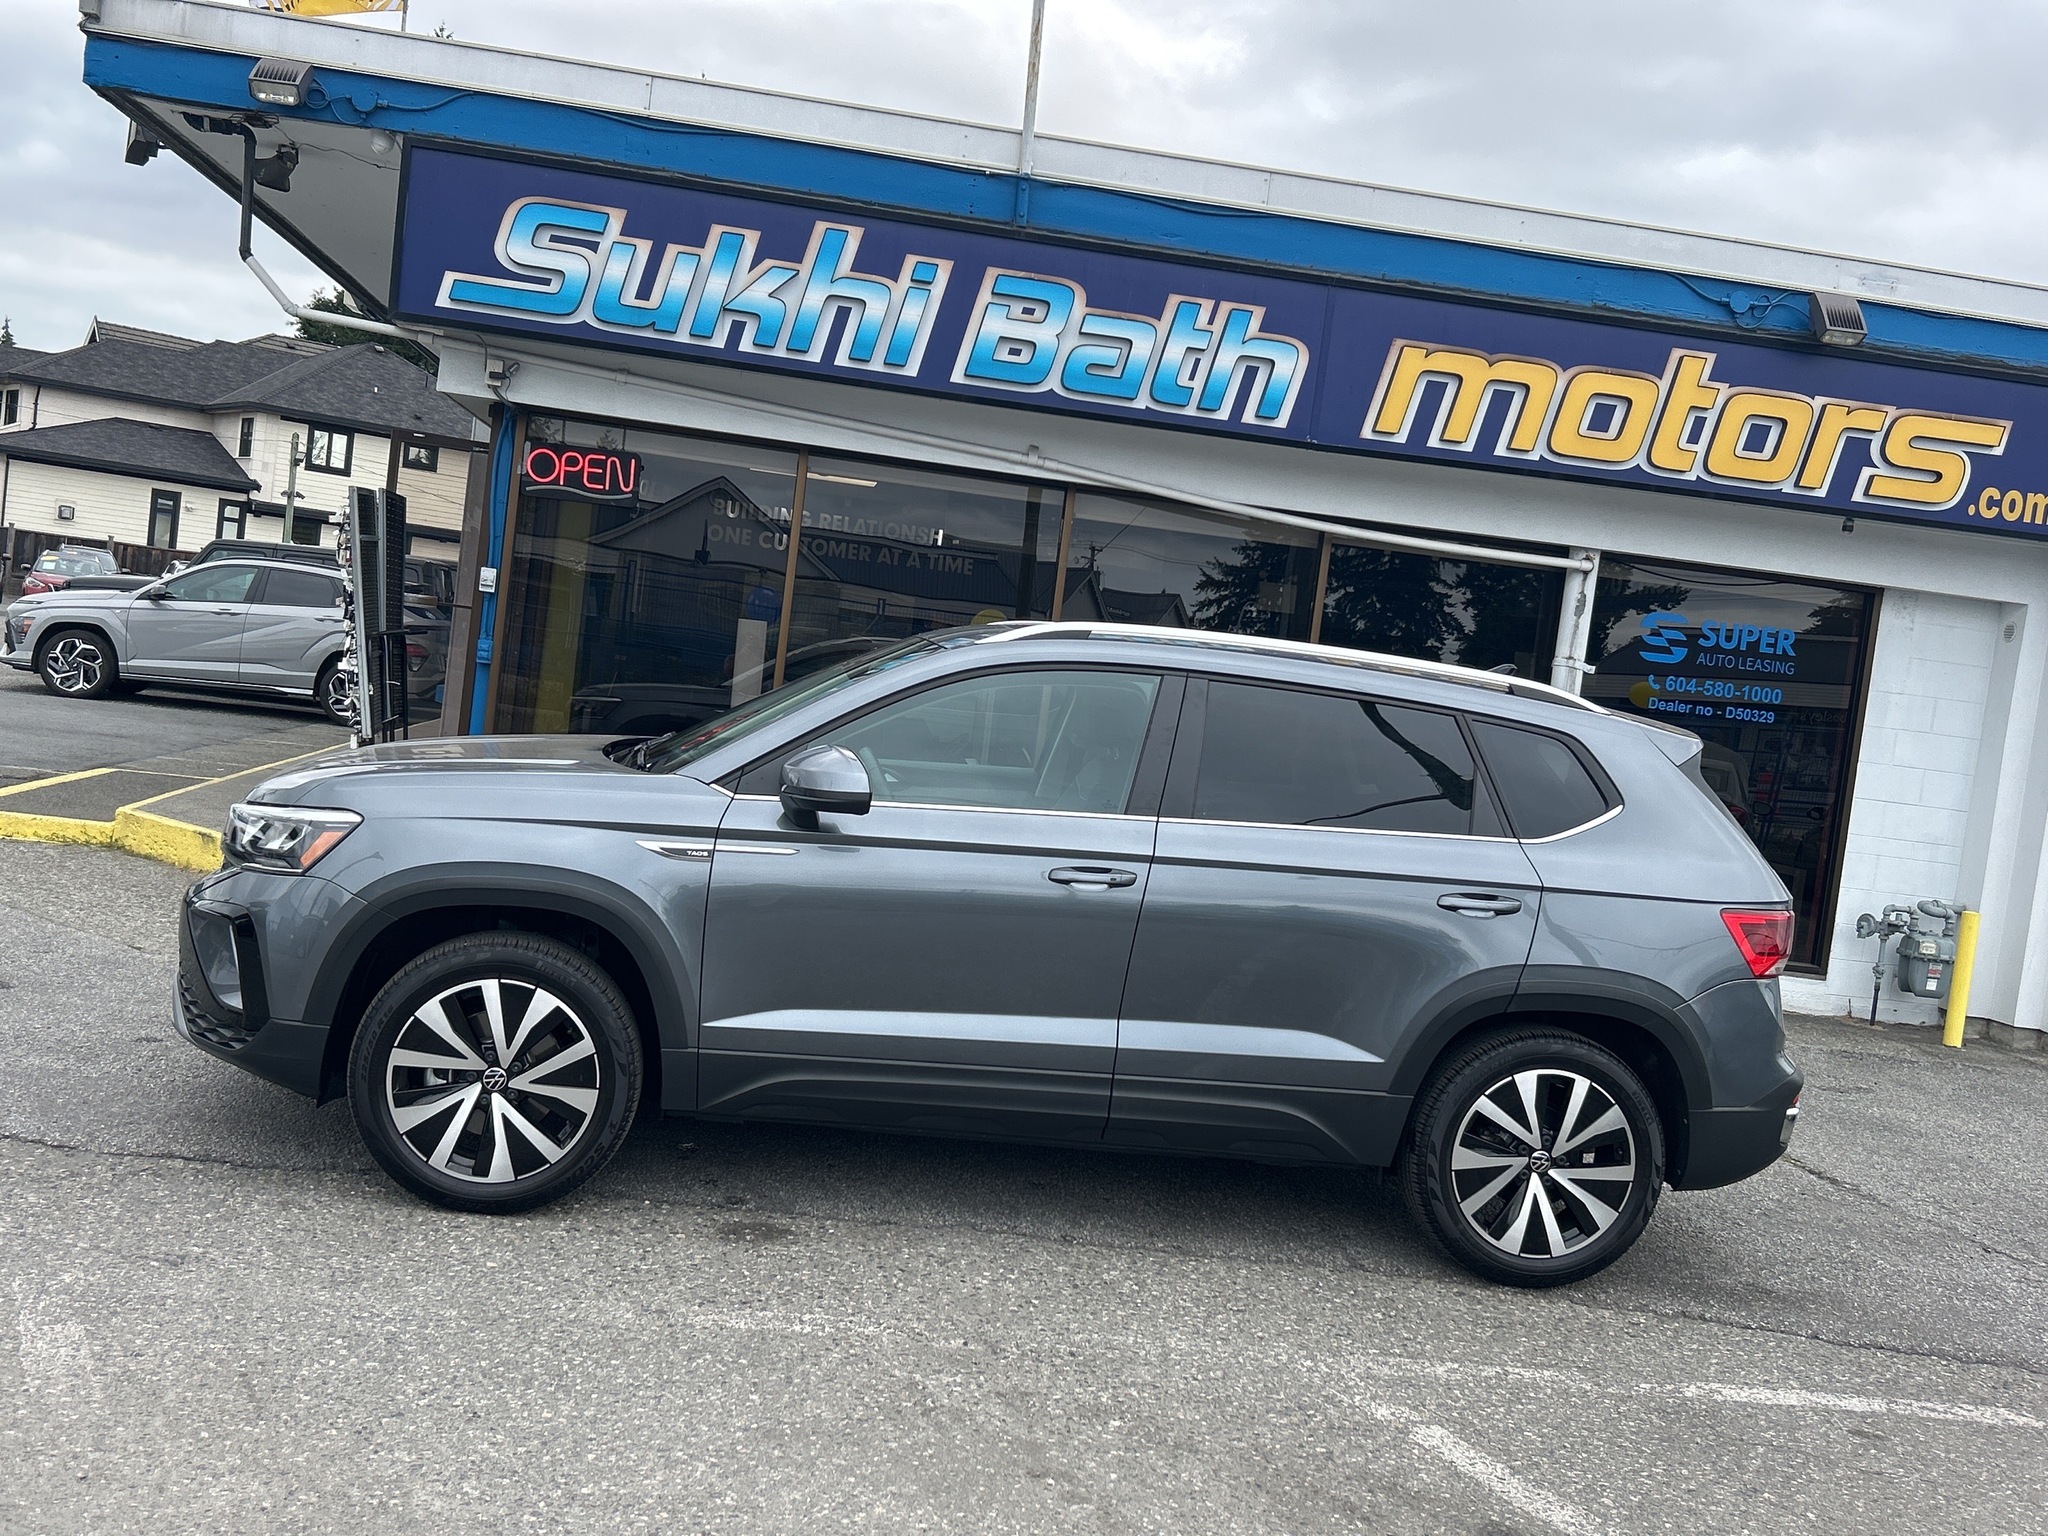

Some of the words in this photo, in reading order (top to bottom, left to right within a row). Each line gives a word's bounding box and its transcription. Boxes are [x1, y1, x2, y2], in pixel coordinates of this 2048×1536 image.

[435, 196, 954, 377] Sukhi
[951, 266, 1310, 428] Bath
[1359, 337, 2013, 511] motors
[526, 448, 636, 493] OPEN
[708, 524, 752, 546] ONE
[759, 531, 870, 562] CUTOMER
[876, 547, 902, 566] AT
[906, 550, 921, 569] A
[928, 553, 974, 575] TIME
[1697, 619, 1797, 657] SUPER
[1696, 653, 1735, 669] AUTO
[1738, 657, 1795, 675] LEASING
[1665, 675, 1782, 704] 604-580-1000
[1648, 697, 1692, 713] Dealer
[1695, 705, 1713, 716] no
[1725, 706, 1775, 724] D50329
